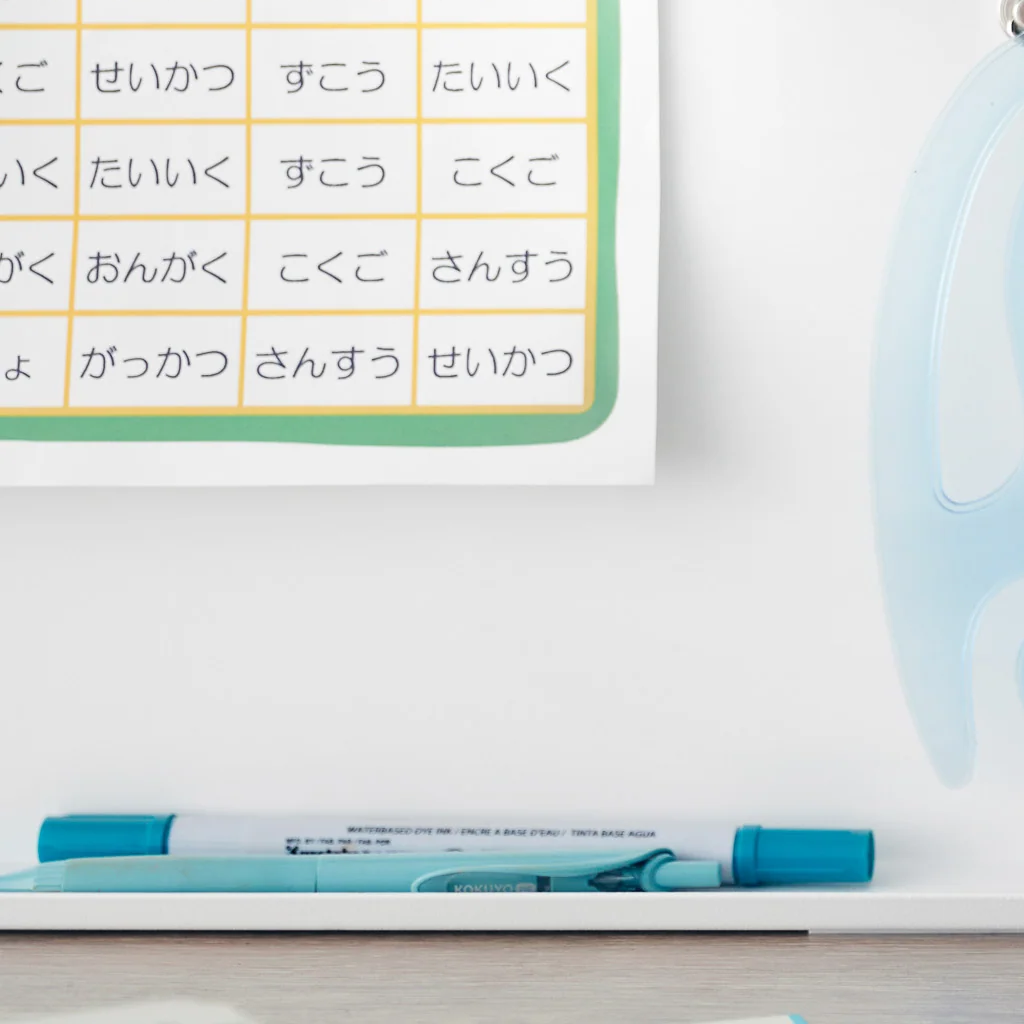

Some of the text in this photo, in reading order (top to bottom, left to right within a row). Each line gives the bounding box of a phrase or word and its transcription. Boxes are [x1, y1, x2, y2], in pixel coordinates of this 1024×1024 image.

[0, 59, 570, 94] ご せいかつ ずこう たいいく
[89, 156, 230, 189] たいいく
[279, 155, 386, 189] ずこう
[453, 154, 559, 187] こくご
[86, 250, 228, 284] おんがく
[279, 249, 388, 283] こくご
[431, 250, 573, 284] さんすう
[79, 345, 229, 380] がっかつ
[255, 346, 400, 380] さんすう
[428, 345, 574, 379] せいかつ
[454, 884, 513, 892] KOKUYO
